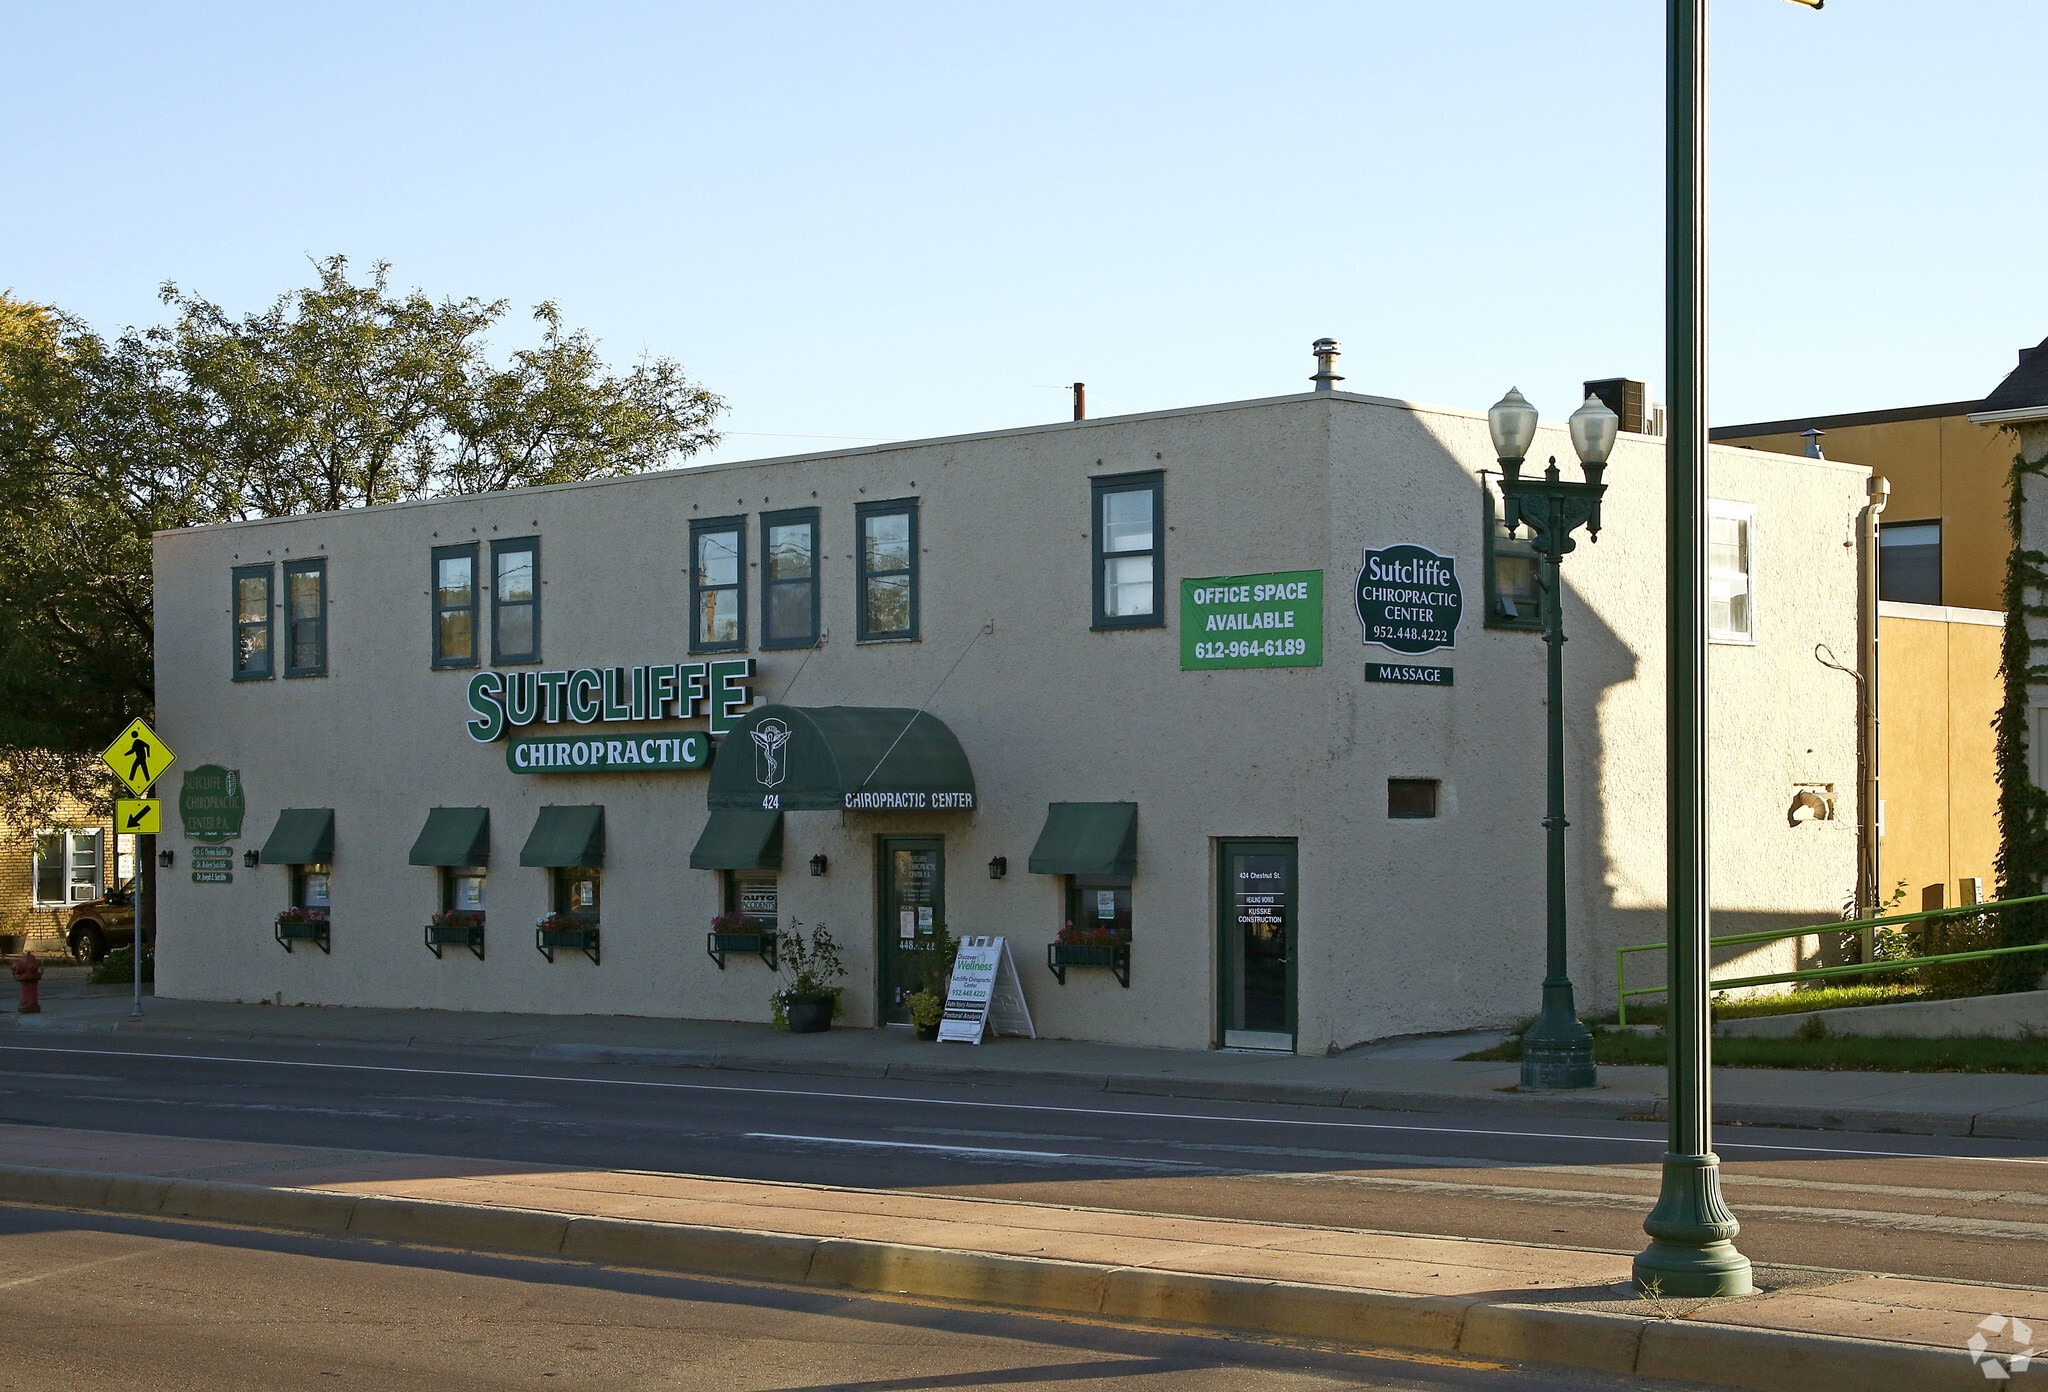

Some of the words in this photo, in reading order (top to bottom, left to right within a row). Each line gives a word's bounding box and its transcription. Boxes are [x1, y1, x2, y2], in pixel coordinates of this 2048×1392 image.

[1369, 556, 1450, 587] Sutcliffe
[1194, 586, 1250, 605] OFFICE
[1254, 582, 1308, 601] SPACE
[1362, 586, 1457, 607] CHIROPRACTIC
[1205, 611, 1294, 632] AVAILABLE
[1384, 605, 1433, 623] CENTER
[1373, 625, 1448, 642] 952.448.4222
[1195, 638, 1306, 659] 612-964-6189
[1379, 667, 1441, 682] MASSAGE
[466, 659, 751, 743] SUTCLIFFE
[515, 737, 697, 768] CHIROPRACTIC
[185, 776, 222, 790] SUTCLIFFE
[186, 796, 240, 810] CHIROPRACTIC
[762, 794, 780, 809] 424
[845, 792, 926, 809] CHIROPRACTIC
[932, 792, 973, 808] CENTER
[188, 816, 215, 830] CENTER
[1238, 915, 1282, 923] CONSTRUCTION
[957, 960, 993, 971] Wellness
[952, 989, 986, 998] 952.448.4222
[963, 1012, 981, 1021] Analysis
